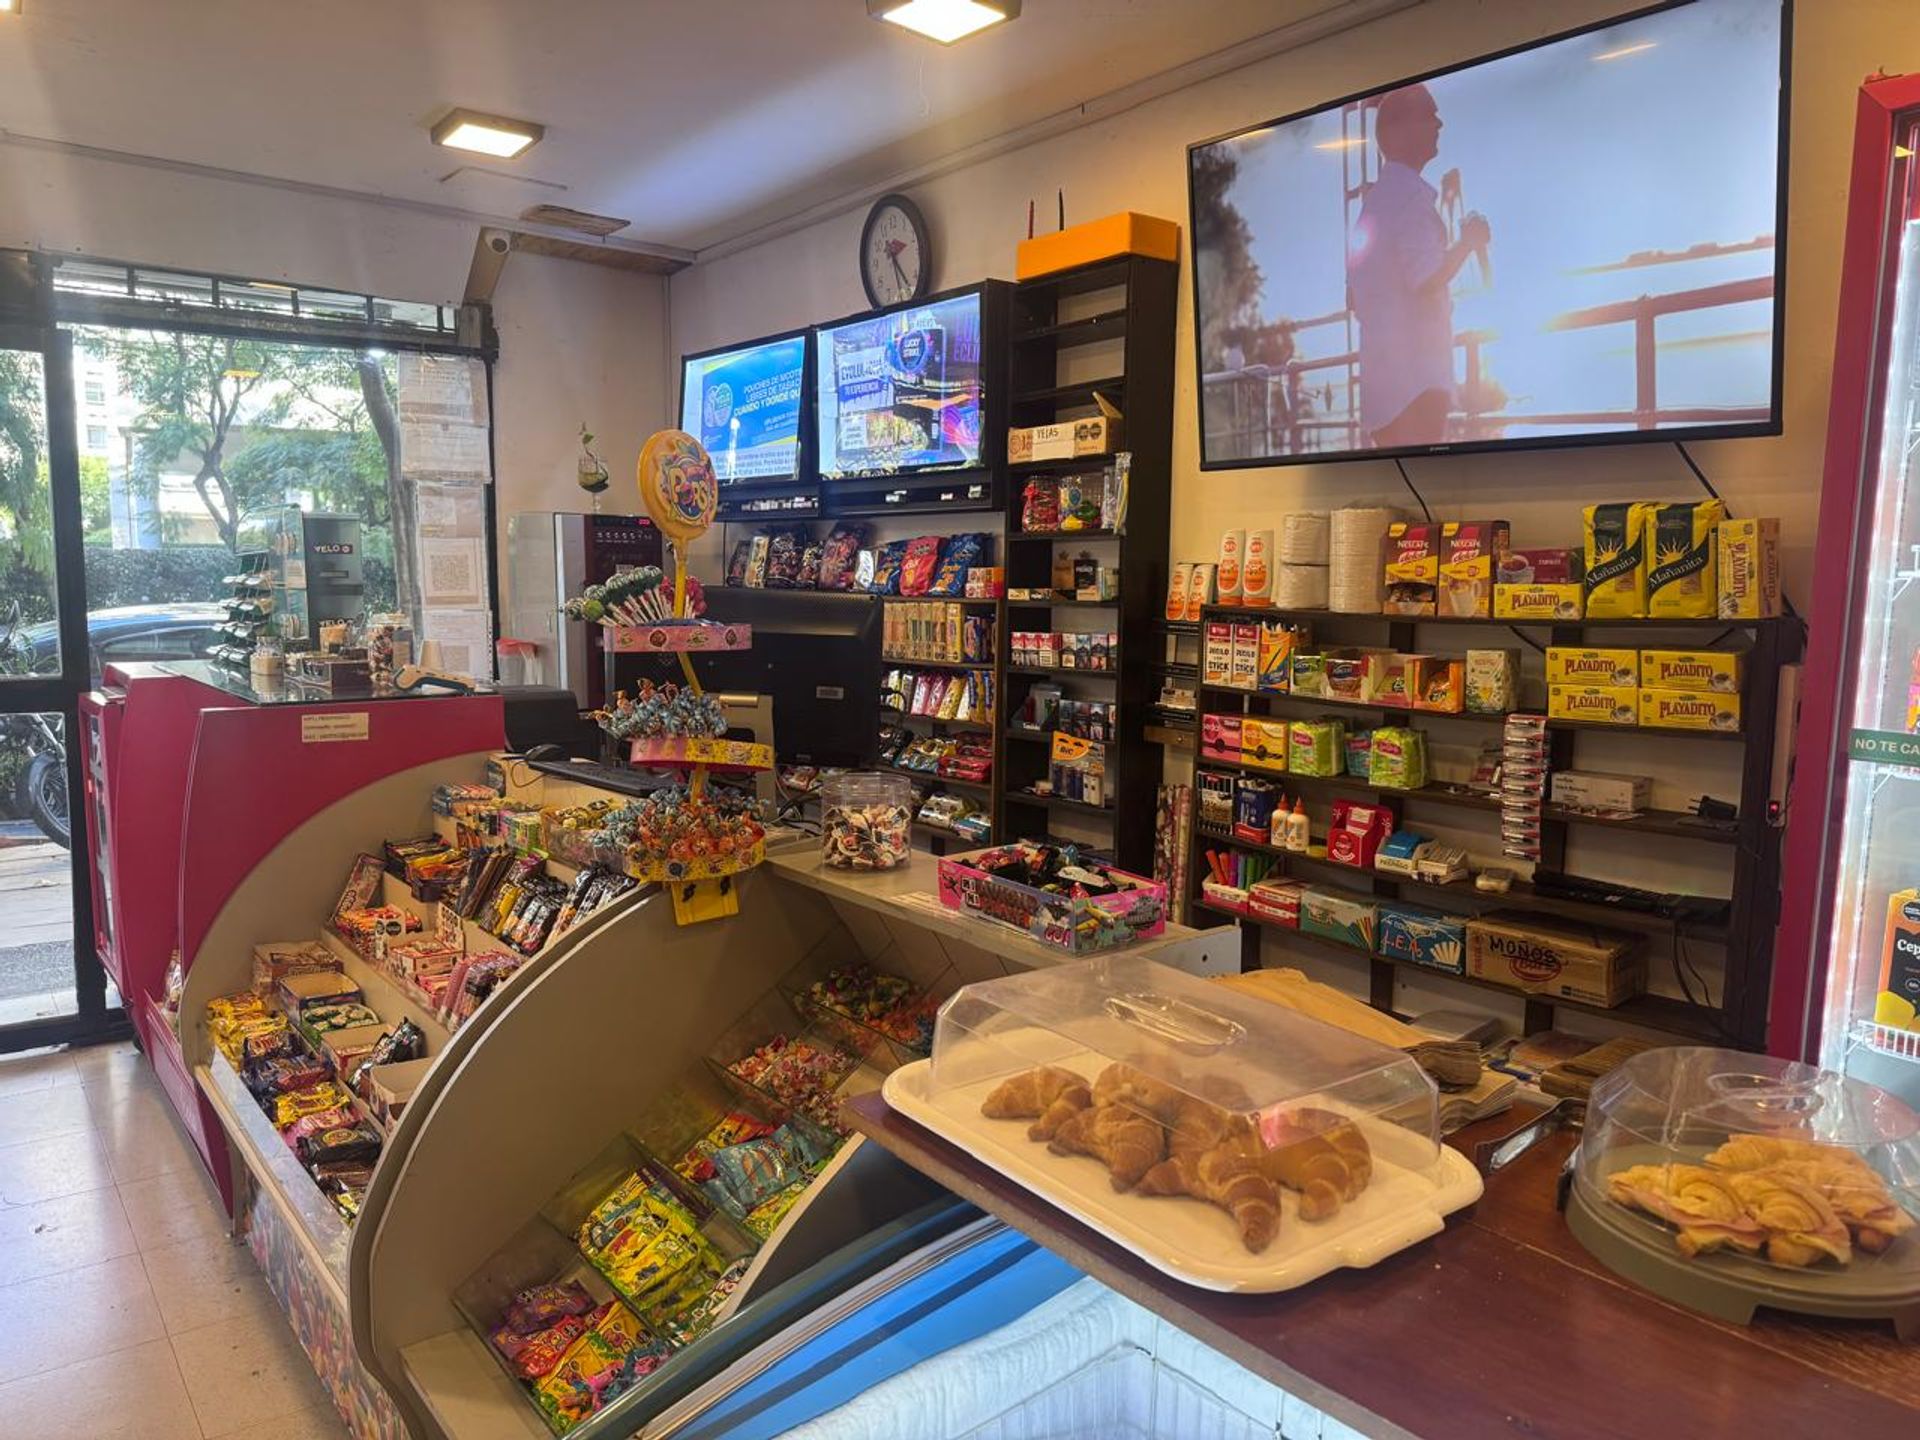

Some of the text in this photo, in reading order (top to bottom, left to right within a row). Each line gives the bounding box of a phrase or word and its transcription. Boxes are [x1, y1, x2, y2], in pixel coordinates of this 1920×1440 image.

[733, 400, 760, 417] CUANDO
[766, 391, 788, 406] DONDE
[314, 545, 341, 554] VELO
[1588, 556, 1637, 587] Mañanita
[1649, 557, 1703, 589] Mañanita
[1728, 543, 1746, 598] PLAYADITO
[1512, 592, 1560, 608] PLAYADITO
[1208, 661, 1230, 672] STICK
[1235, 663, 1256, 674] STICK
[1565, 658, 1616, 676] PLAYADITO
[1660, 663, 1714, 682] PLAYADITO
[1567, 693, 1617, 711] PLAYADITO
[1659, 700, 1717, 719] PLAYADITO
[1855, 737, 1877, 751] NO
[1880, 739, 1898, 753] TE
[1489, 935, 1557, 967] MOÑOS
